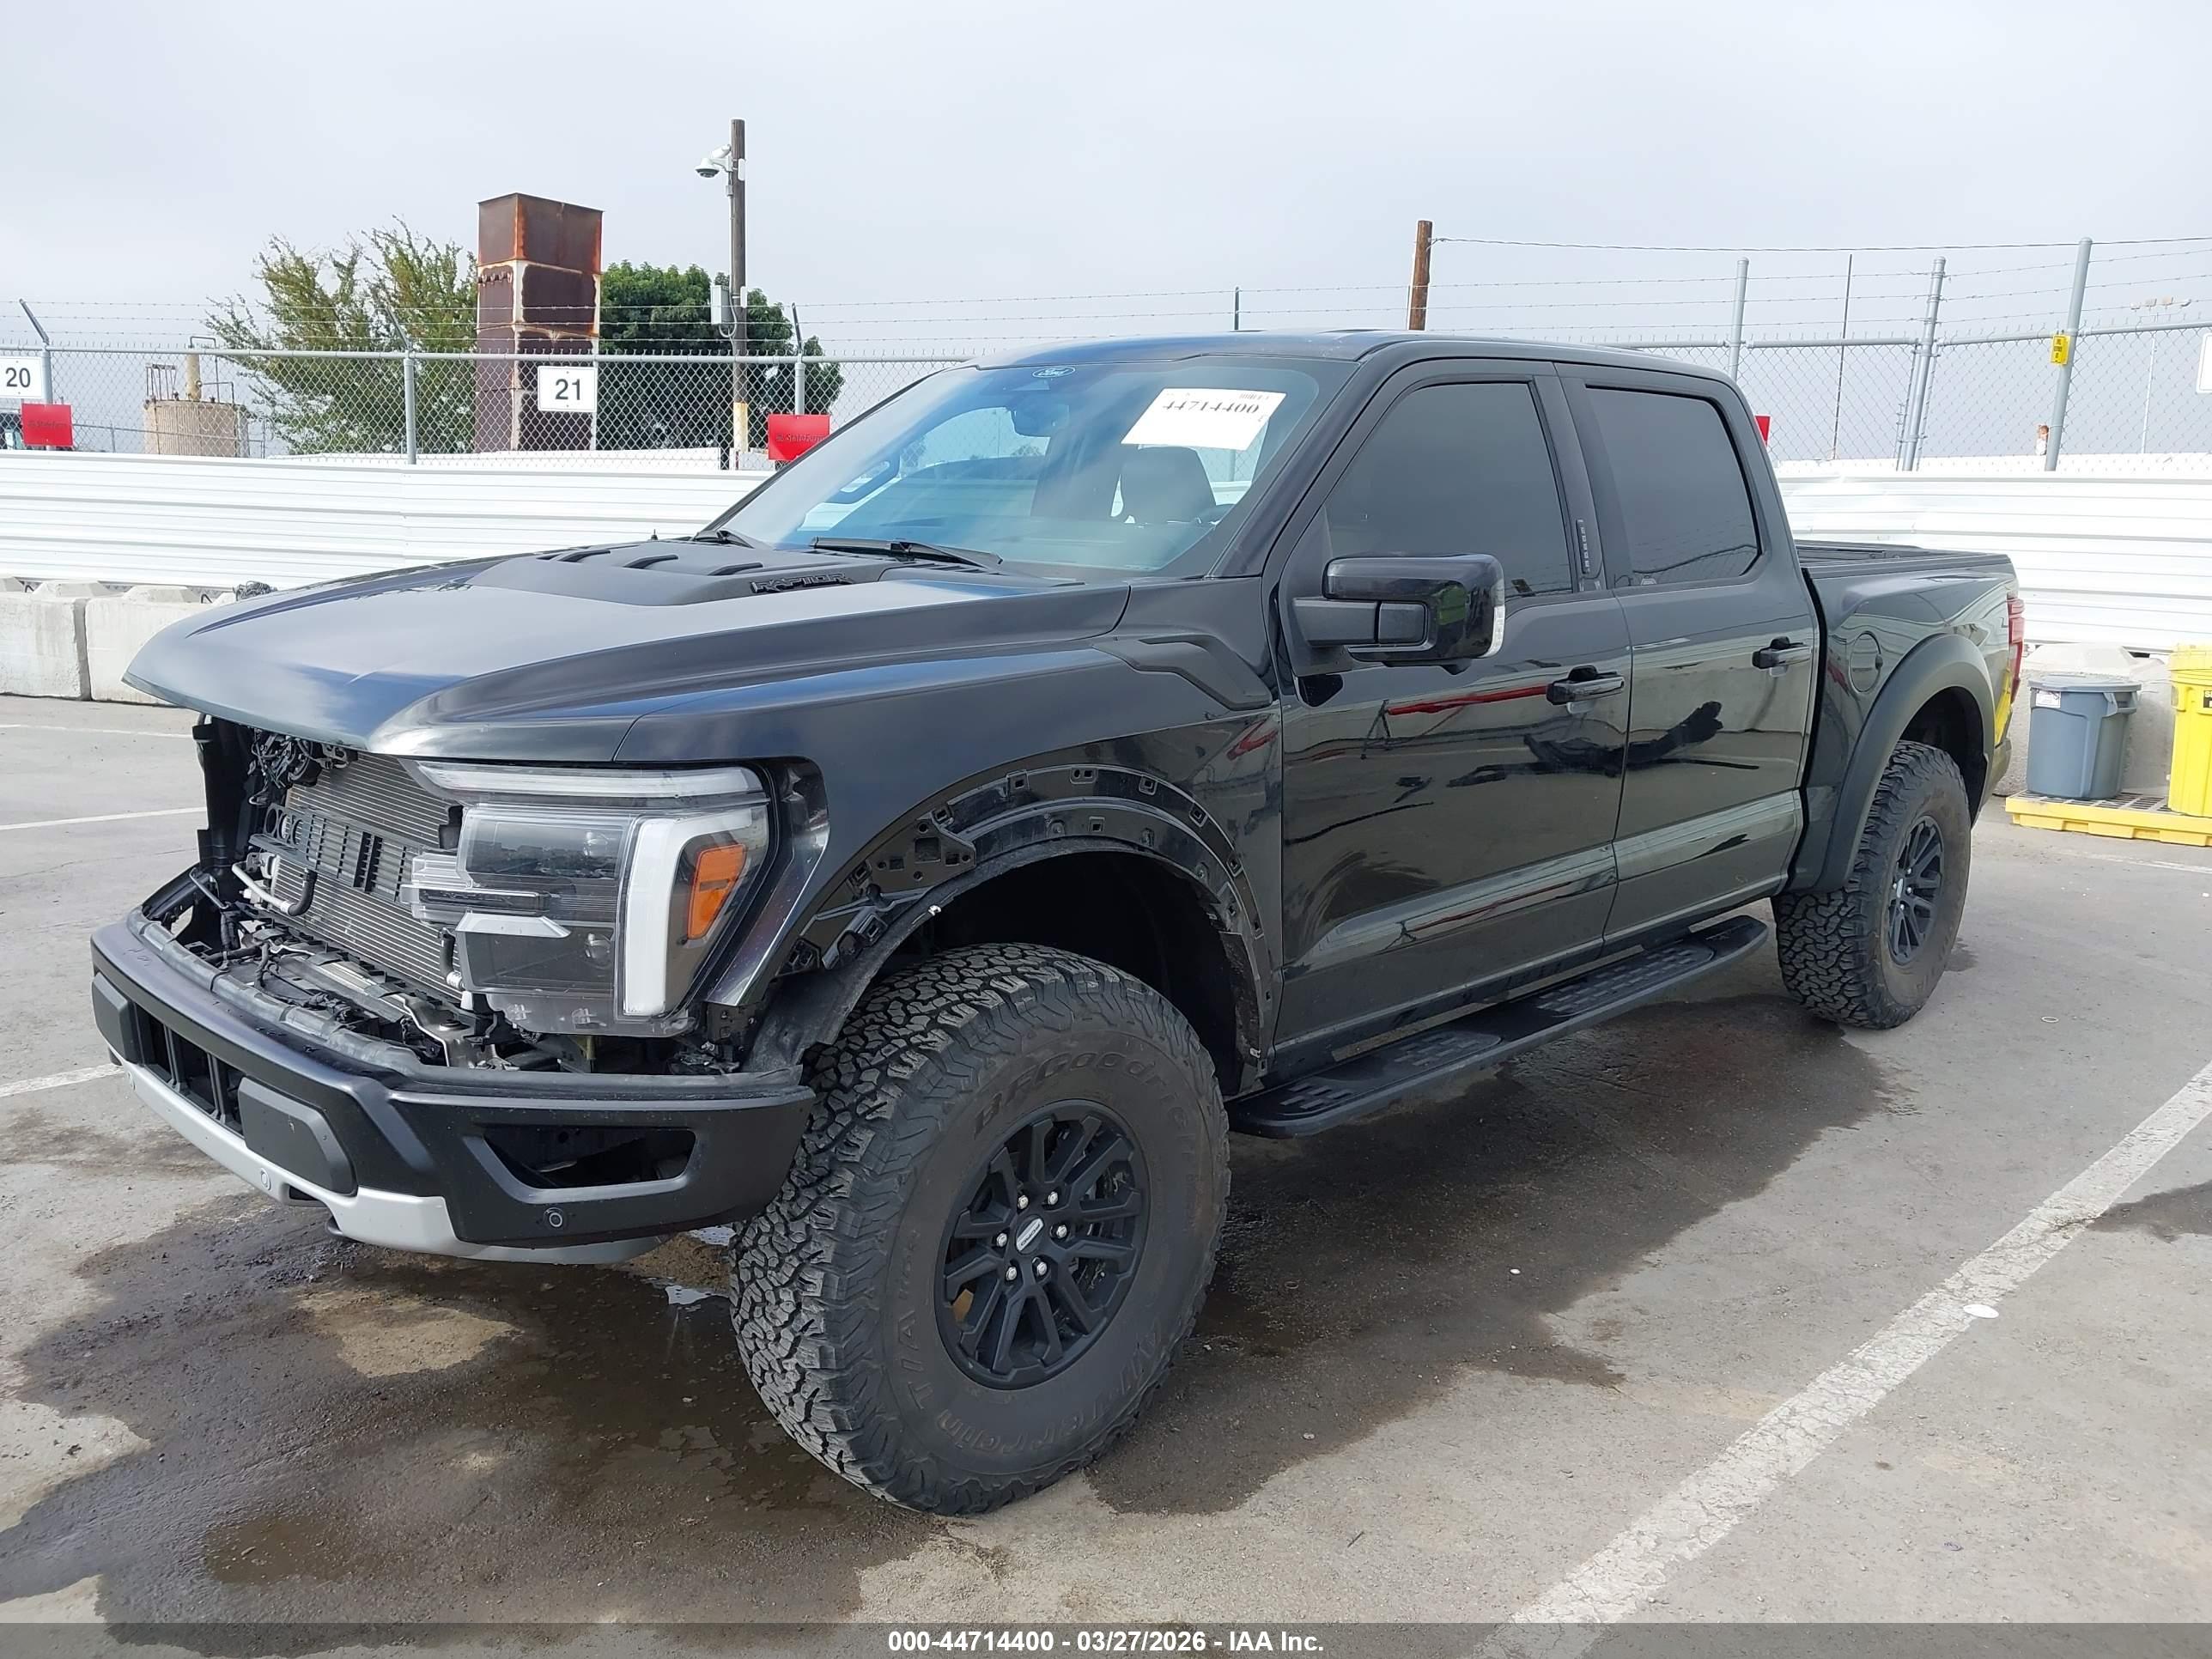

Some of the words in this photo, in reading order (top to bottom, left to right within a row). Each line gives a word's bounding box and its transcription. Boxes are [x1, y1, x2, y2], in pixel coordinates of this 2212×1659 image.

[5, 368, 31, 388] 20
[556, 379, 580, 400] 21
[1163, 400, 1260, 414] 44714400
[750, 573, 855, 593] RAPTOR
